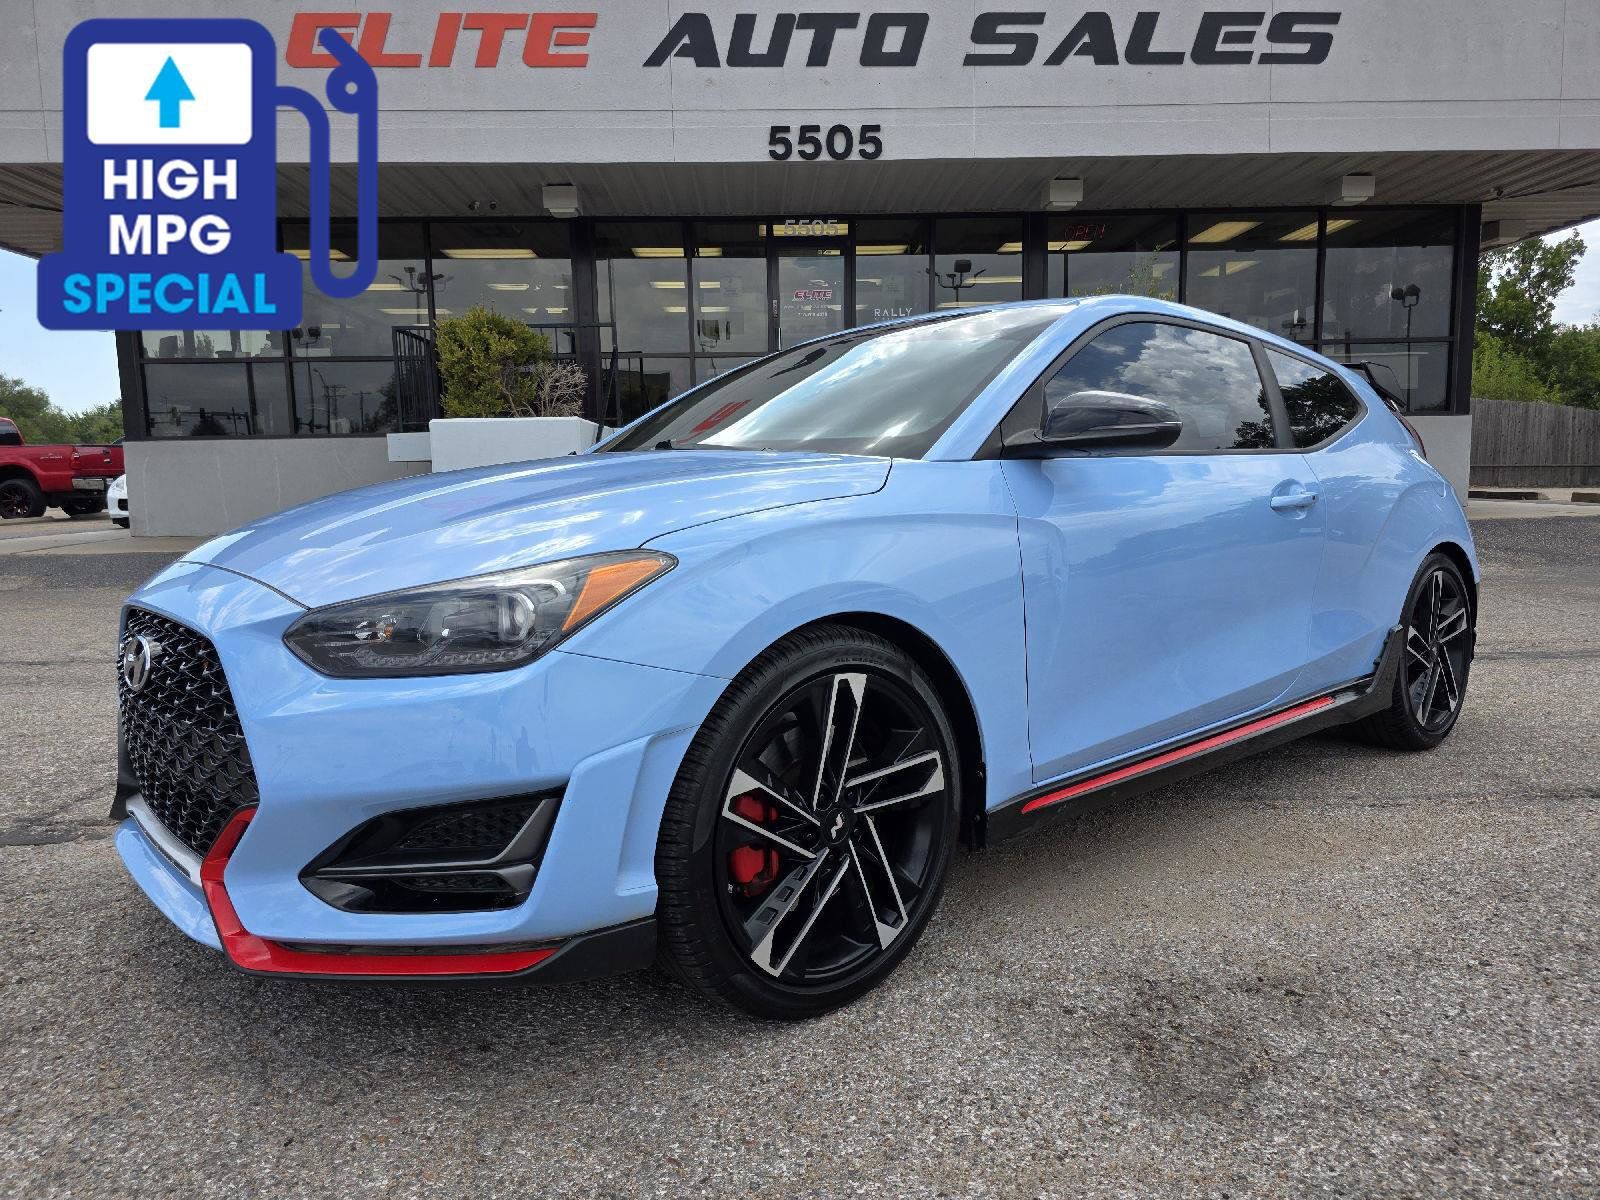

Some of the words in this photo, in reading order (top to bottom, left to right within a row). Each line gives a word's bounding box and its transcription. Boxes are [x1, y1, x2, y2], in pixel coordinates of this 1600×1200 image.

[284, 12, 598, 68] ELITE
[642, 11, 930, 68] AUTO
[962, 11, 1342, 66] SALES
[768, 123, 884, 161] 5505
[783, 219, 839, 237] 5505
[874, 307, 913, 317] RALLY
